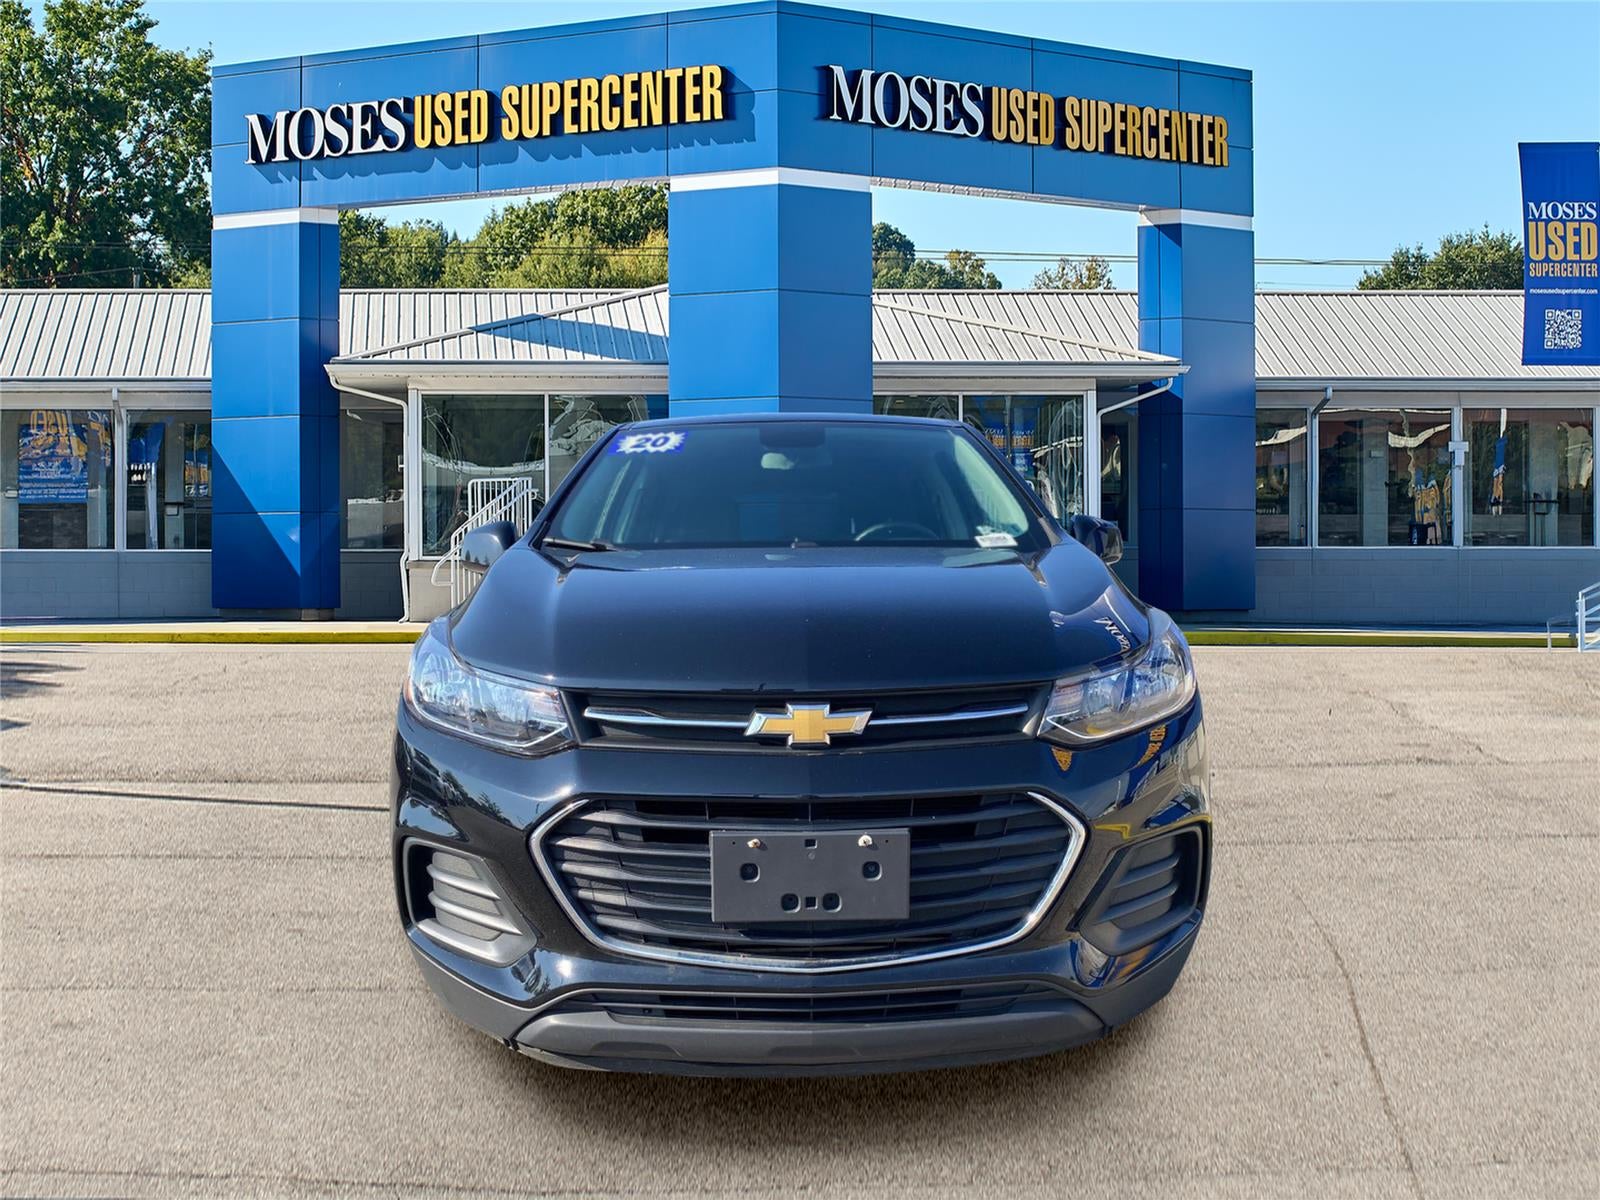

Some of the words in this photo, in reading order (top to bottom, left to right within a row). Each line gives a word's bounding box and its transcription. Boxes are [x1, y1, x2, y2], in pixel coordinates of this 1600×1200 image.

[244, 97, 407, 164] MOSES
[413, 89, 488, 149] USED
[501, 64, 724, 141] SUPERCENTER
[829, 64, 984, 137] MOSES
[991, 86, 1055, 145] USED
[1065, 96, 1229, 167] SUPERCENTER
[1527, 201, 1597, 220] MOSES
[1528, 221, 1598, 261] USED
[1529, 263, 1598, 278] SUPERCENTER
[630, 436, 671, 448] 20
